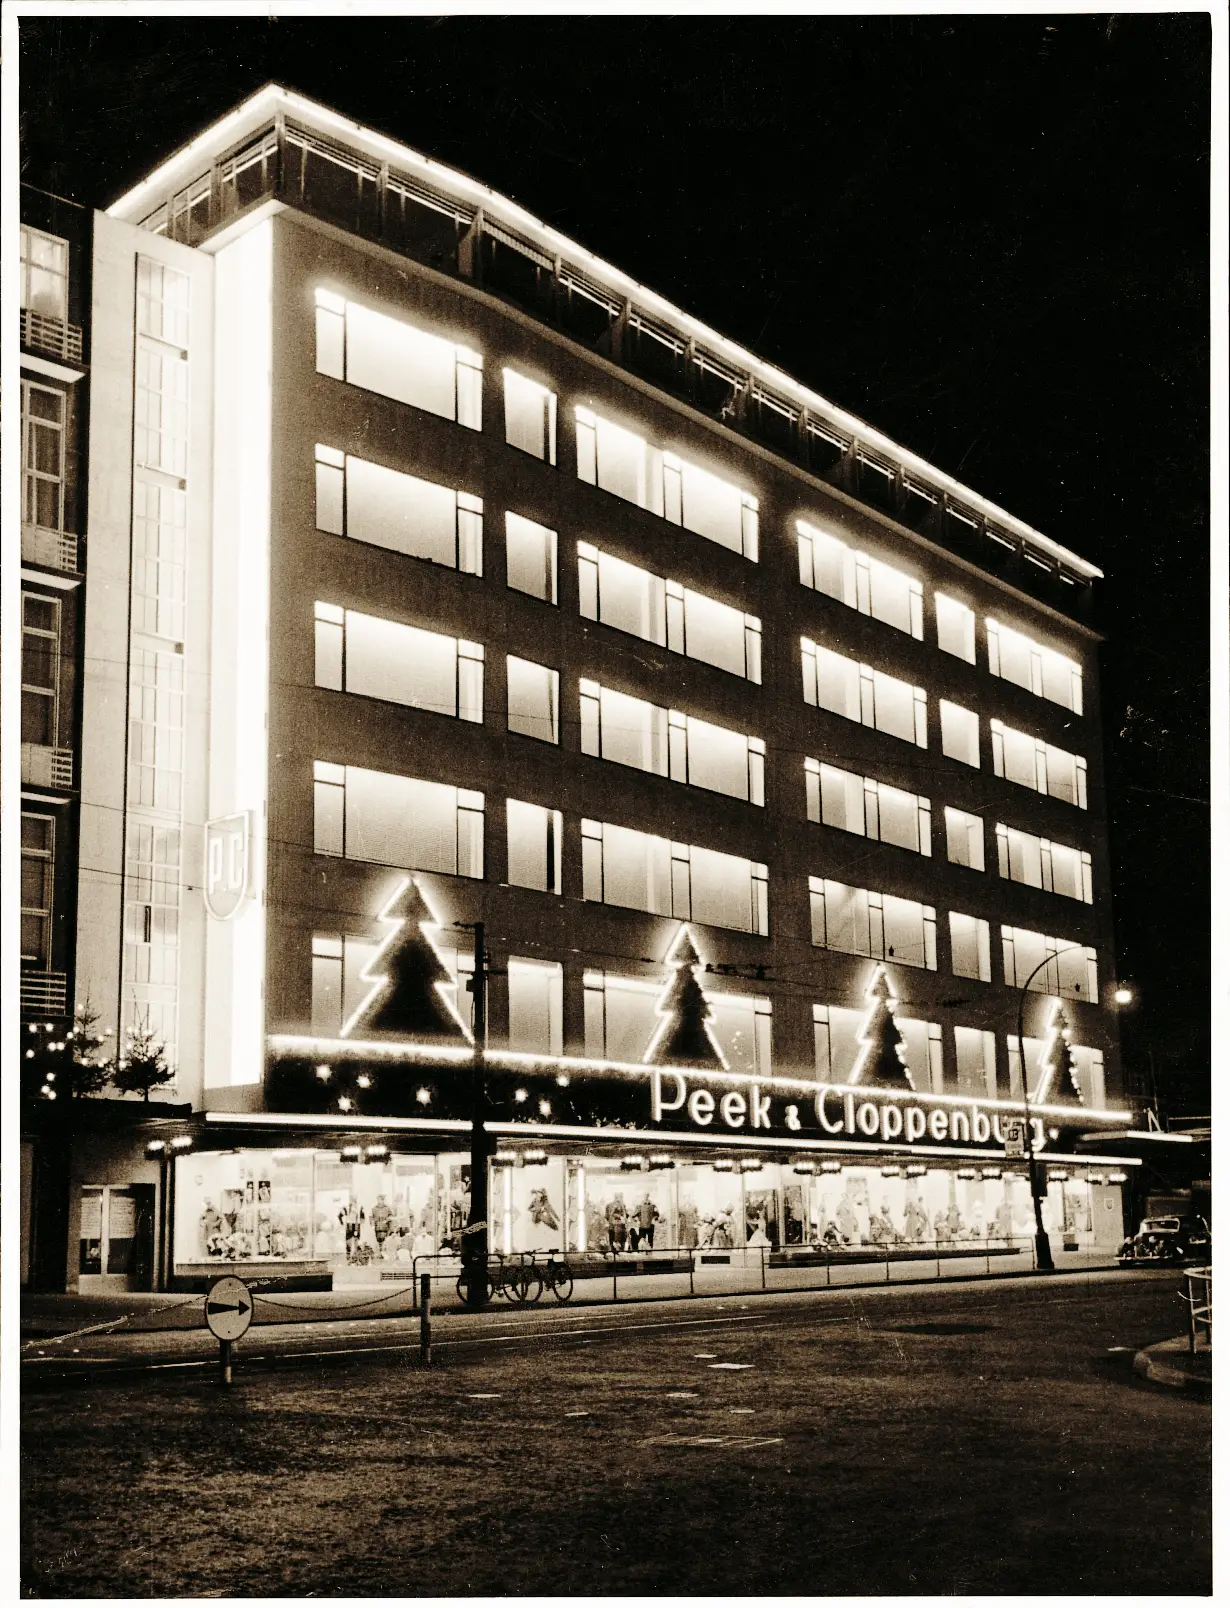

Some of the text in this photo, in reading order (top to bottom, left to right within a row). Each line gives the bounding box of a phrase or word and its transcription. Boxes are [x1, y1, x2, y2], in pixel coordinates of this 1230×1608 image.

[650, 1069, 1047, 1152] Peek & Cloppenbug
